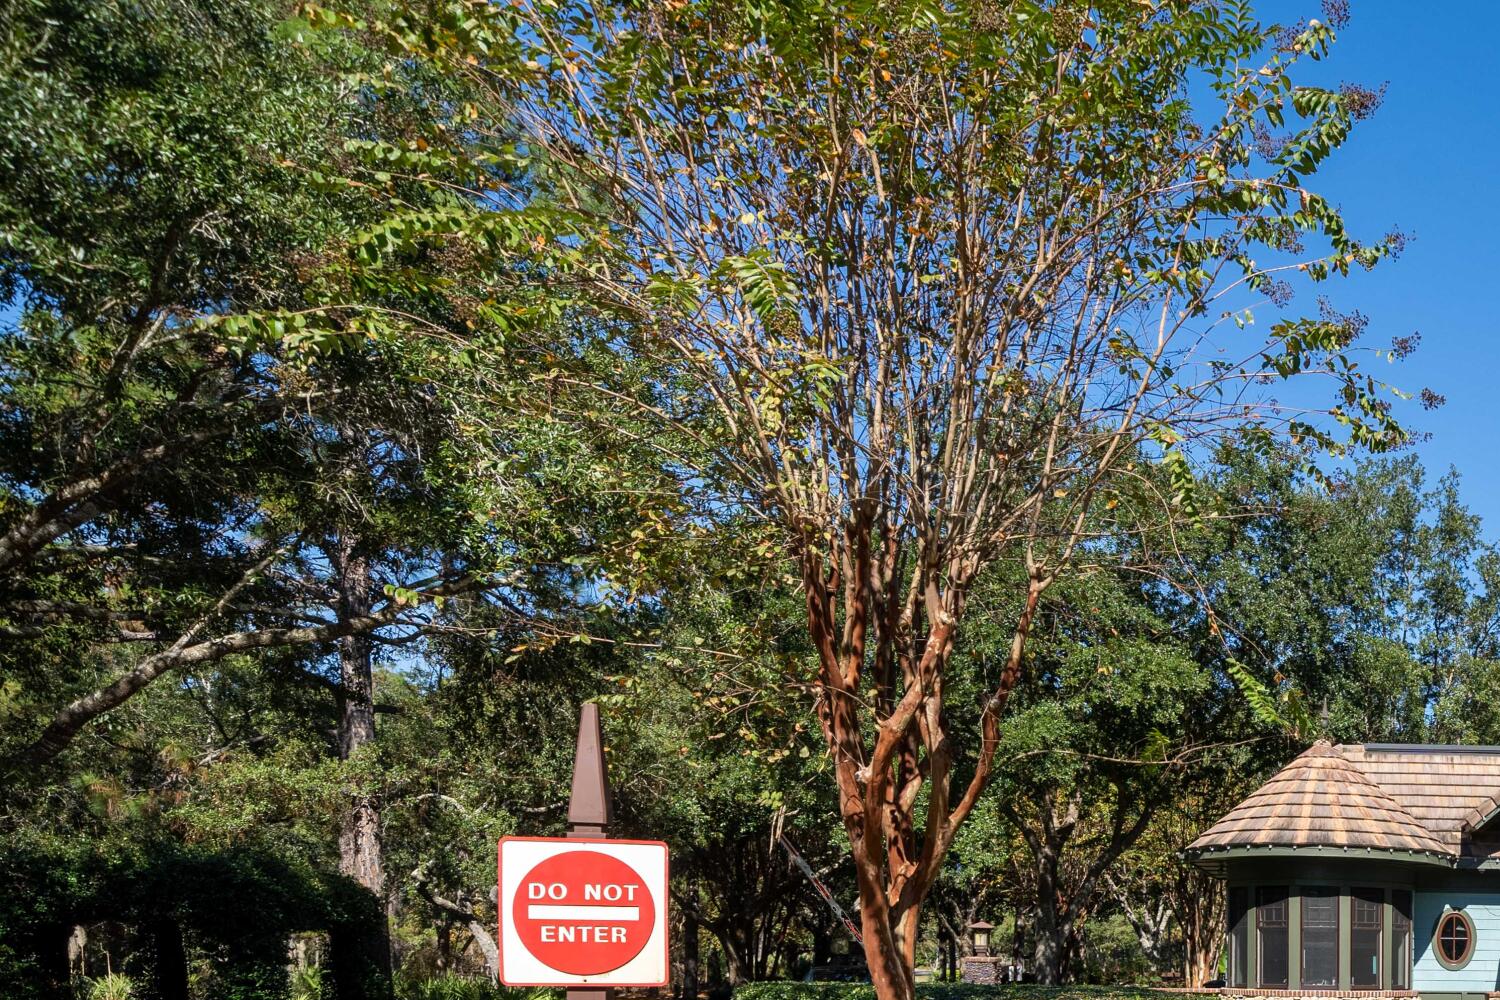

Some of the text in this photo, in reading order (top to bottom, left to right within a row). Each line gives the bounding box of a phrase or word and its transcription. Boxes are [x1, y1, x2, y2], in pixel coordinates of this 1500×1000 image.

[528, 882, 639, 902] DO NOT
[540, 925, 627, 943] ENTER
